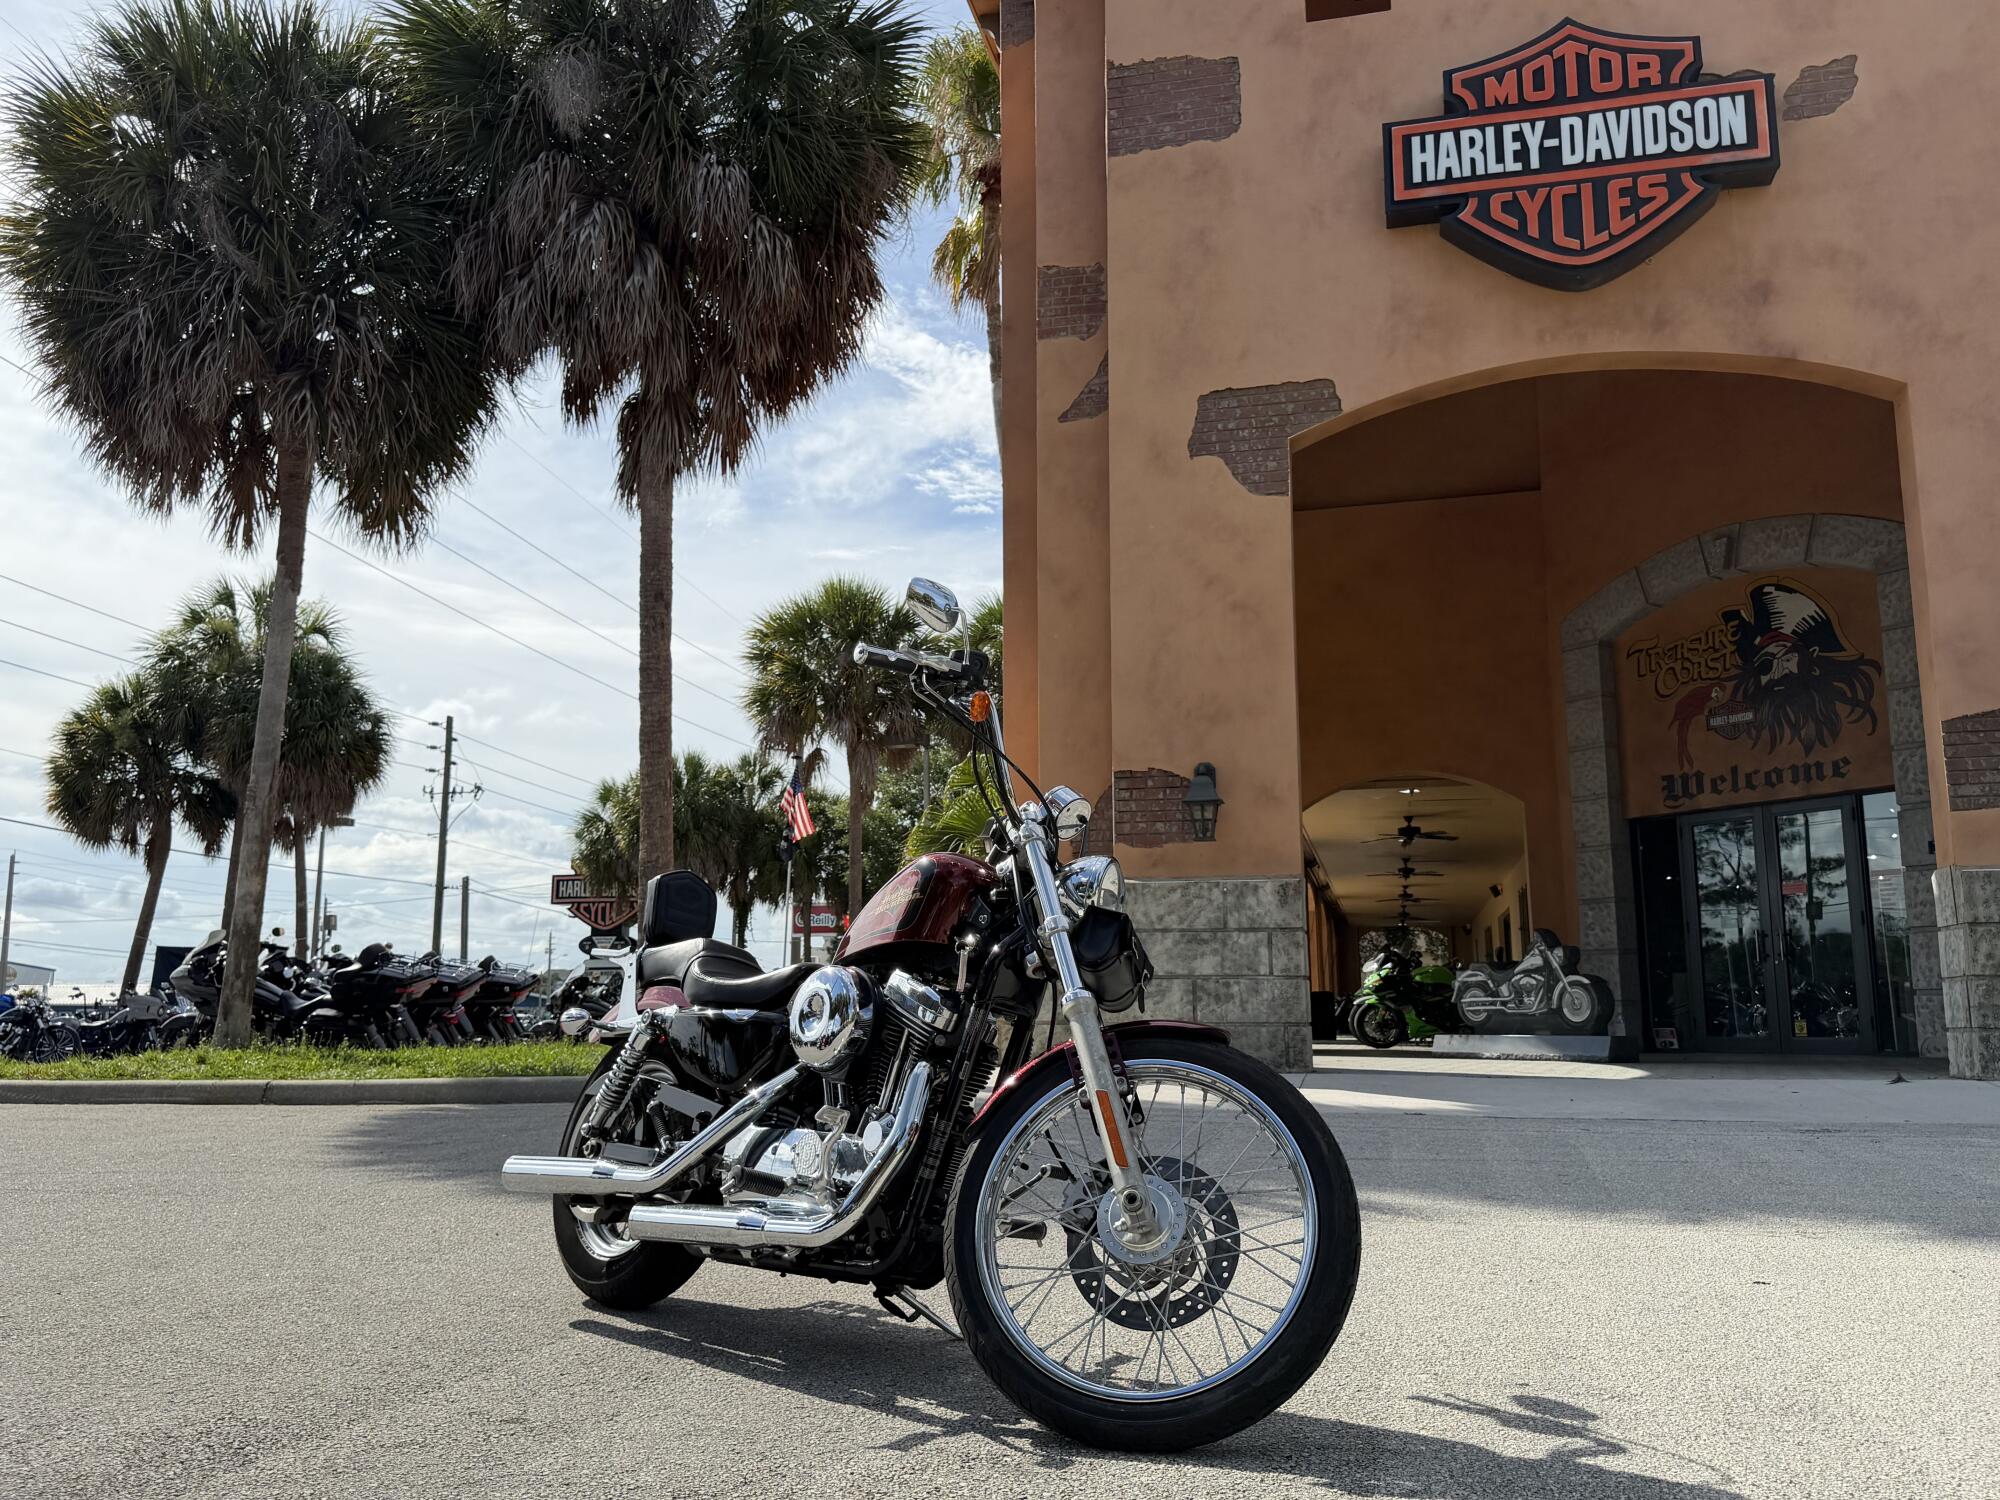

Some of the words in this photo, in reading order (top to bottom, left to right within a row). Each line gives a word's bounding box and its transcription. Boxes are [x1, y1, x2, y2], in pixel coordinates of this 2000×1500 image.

[1484, 40, 1662, 108] MOTOR
[1411, 95, 1748, 184] HARLEY-DAVIDSON
[1490, 173, 1668, 250] CYCLES
[1661, 756, 1852, 809] Welcome
